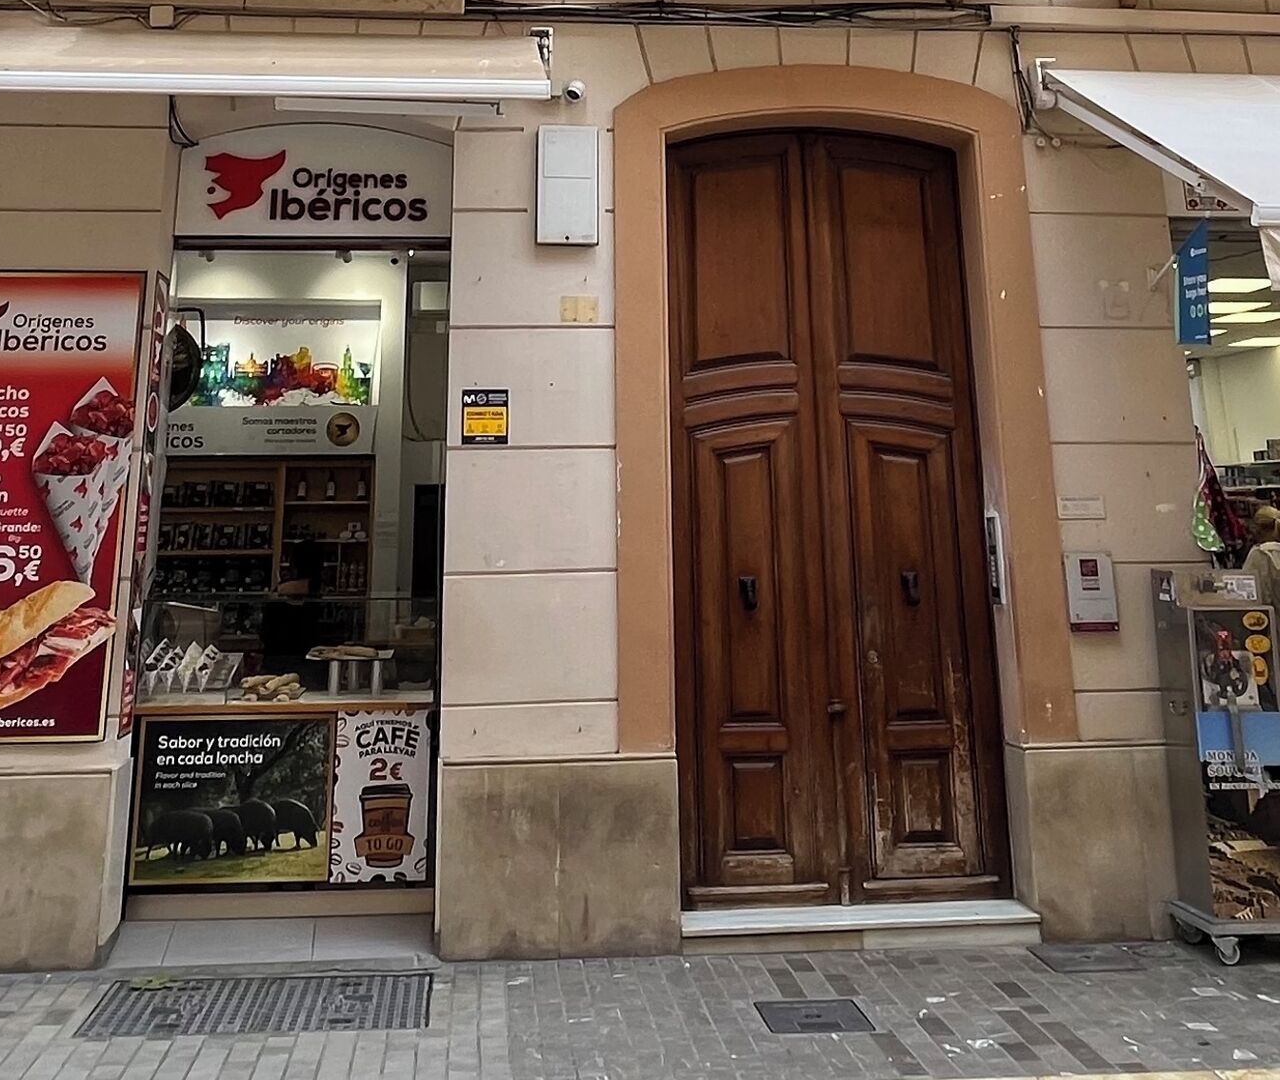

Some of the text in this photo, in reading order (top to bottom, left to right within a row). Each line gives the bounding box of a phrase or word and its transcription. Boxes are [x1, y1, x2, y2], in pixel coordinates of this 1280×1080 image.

[292, 167, 408, 196] Orígenes
[269, 188, 428, 221] Ibéricos
[13, 313, 94, 334] Orígenes
[158, 734, 281, 752] Sabor y tradición
[356, 725, 420, 750] CAFÉ
[156, 751, 263, 765] en cada loncha
[359, 746, 416, 759] PARA LLEVAR
[1207, 750, 1258, 761] MONDA
[369, 758, 403, 781] 2€
[366, 837, 403, 851] TO GO
